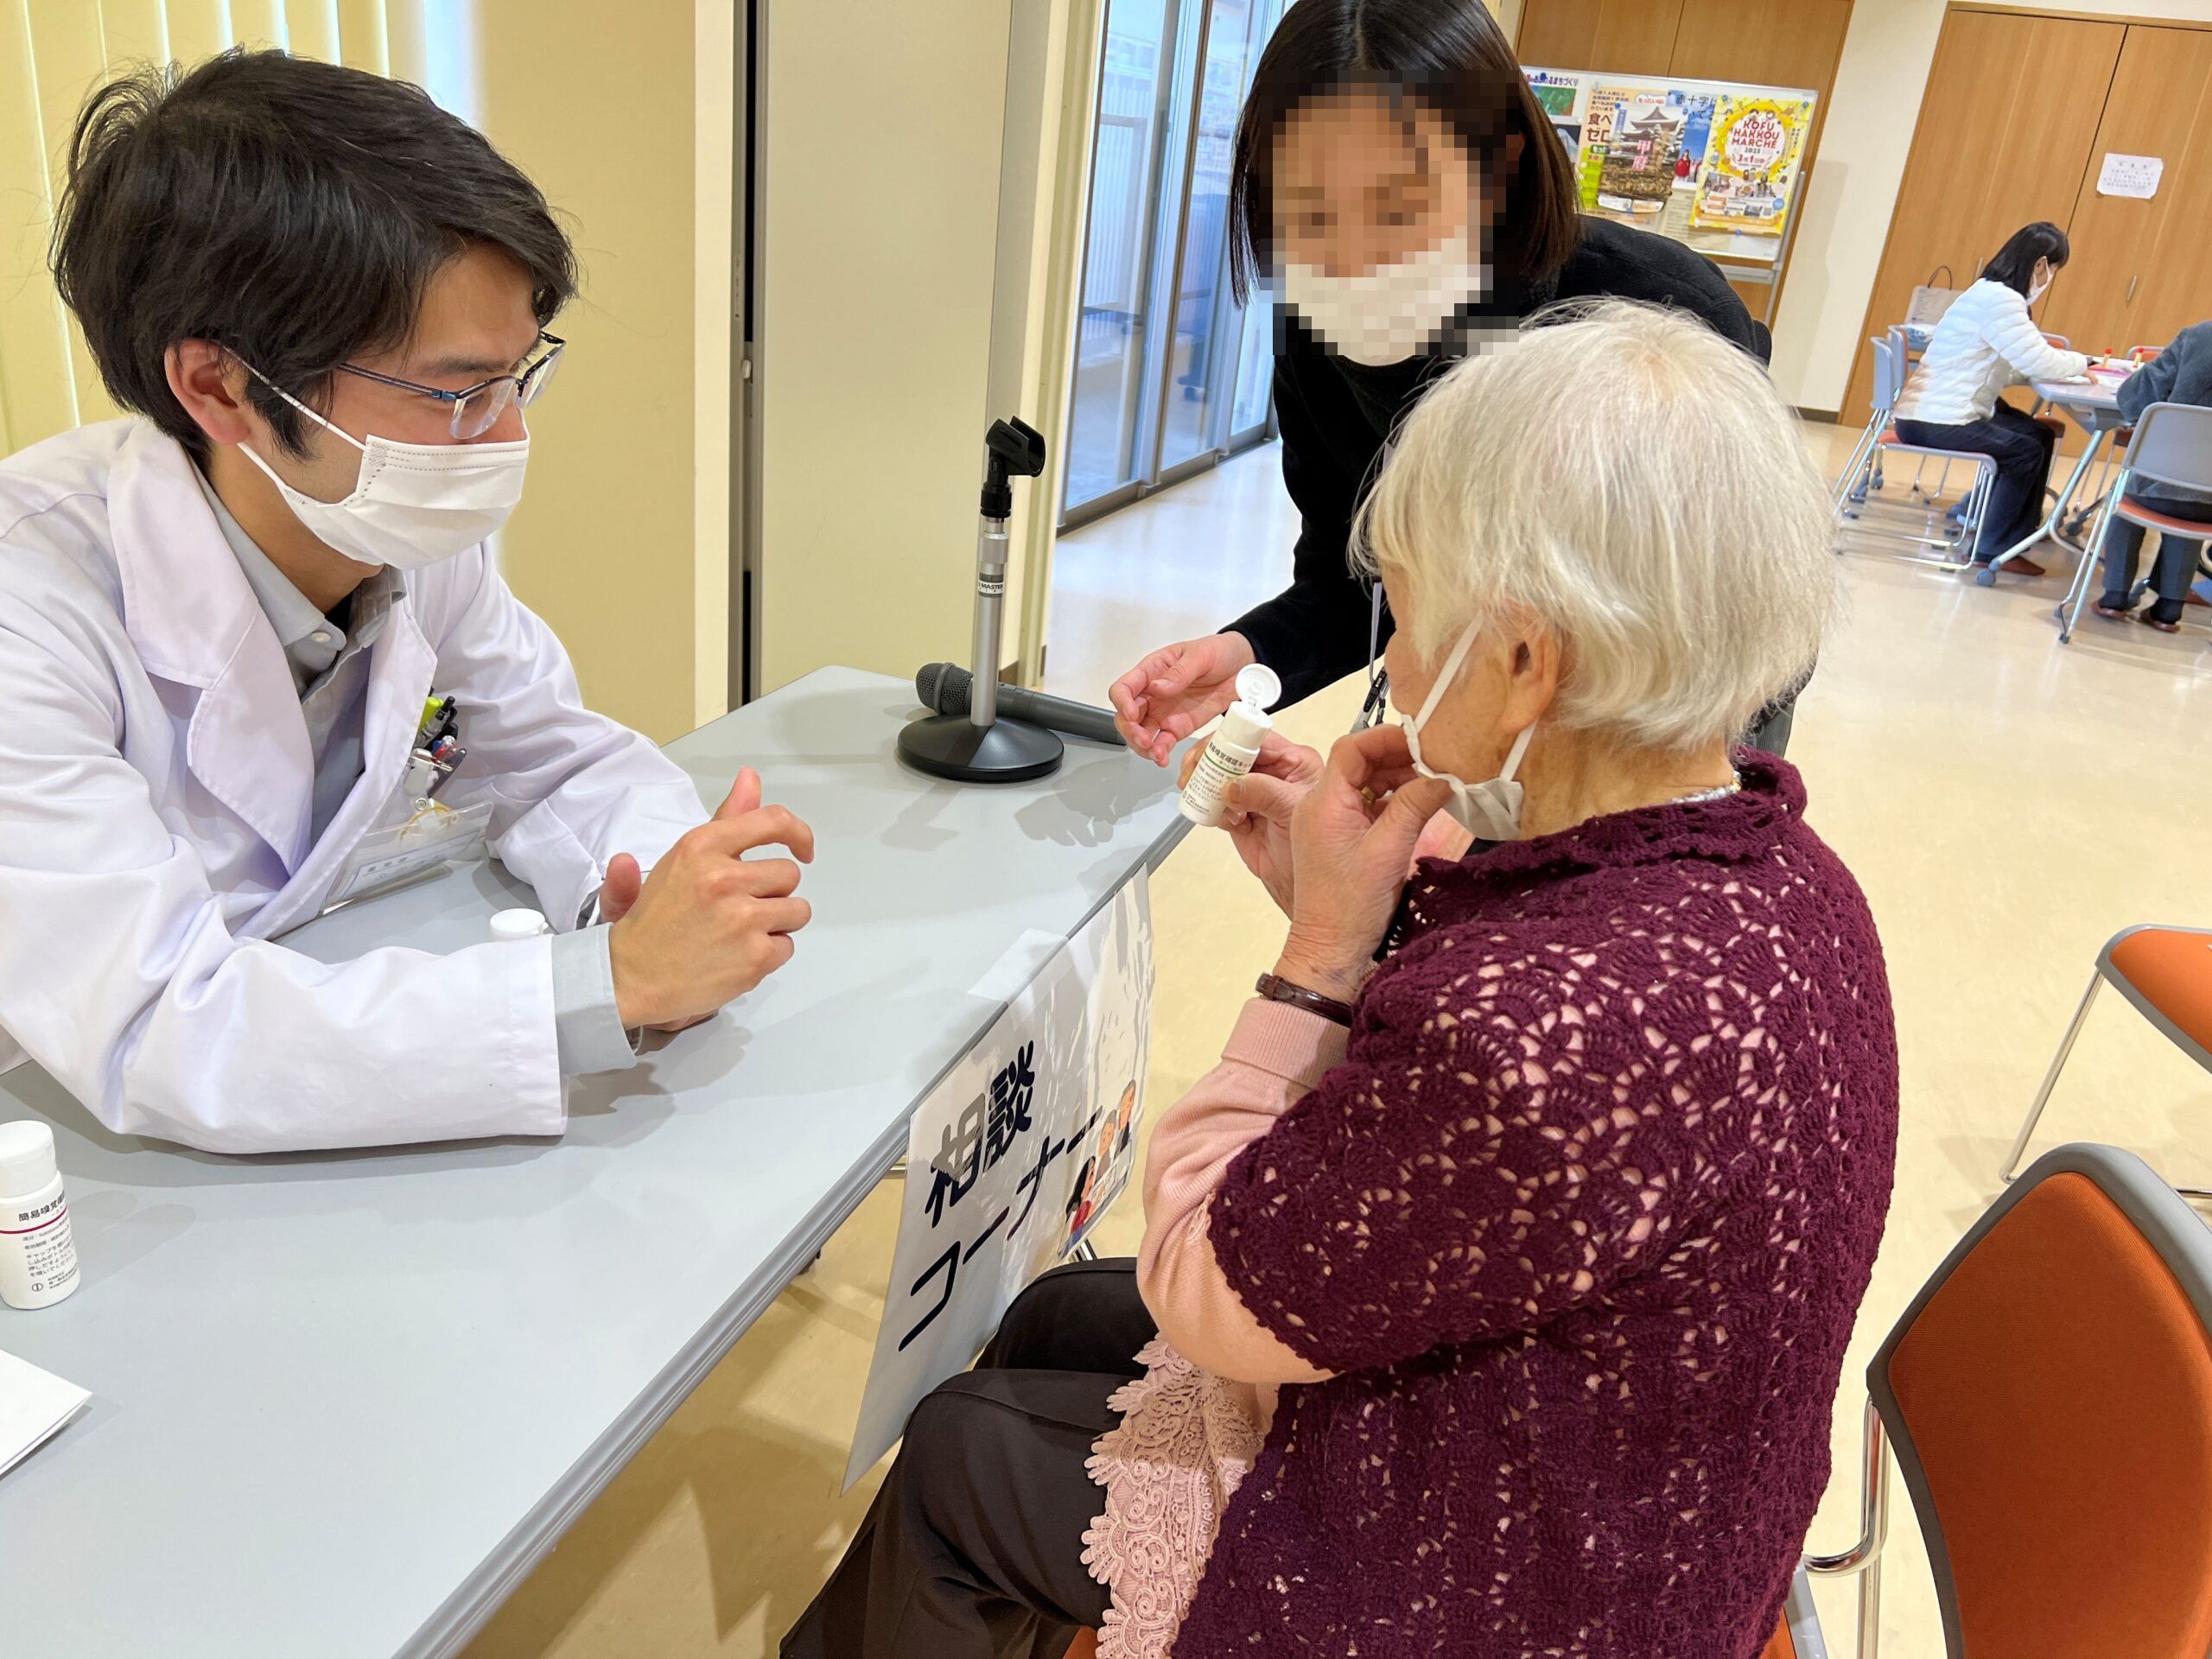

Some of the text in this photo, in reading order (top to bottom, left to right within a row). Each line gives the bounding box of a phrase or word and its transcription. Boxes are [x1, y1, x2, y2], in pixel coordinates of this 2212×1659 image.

[1733, 128, 1780, 140] HAKKOU
[1743, 120, 1775, 131] KOFU
[925, 1039, 1035, 1230] 相談
[898, 1105, 1103, 1351] コーナー
